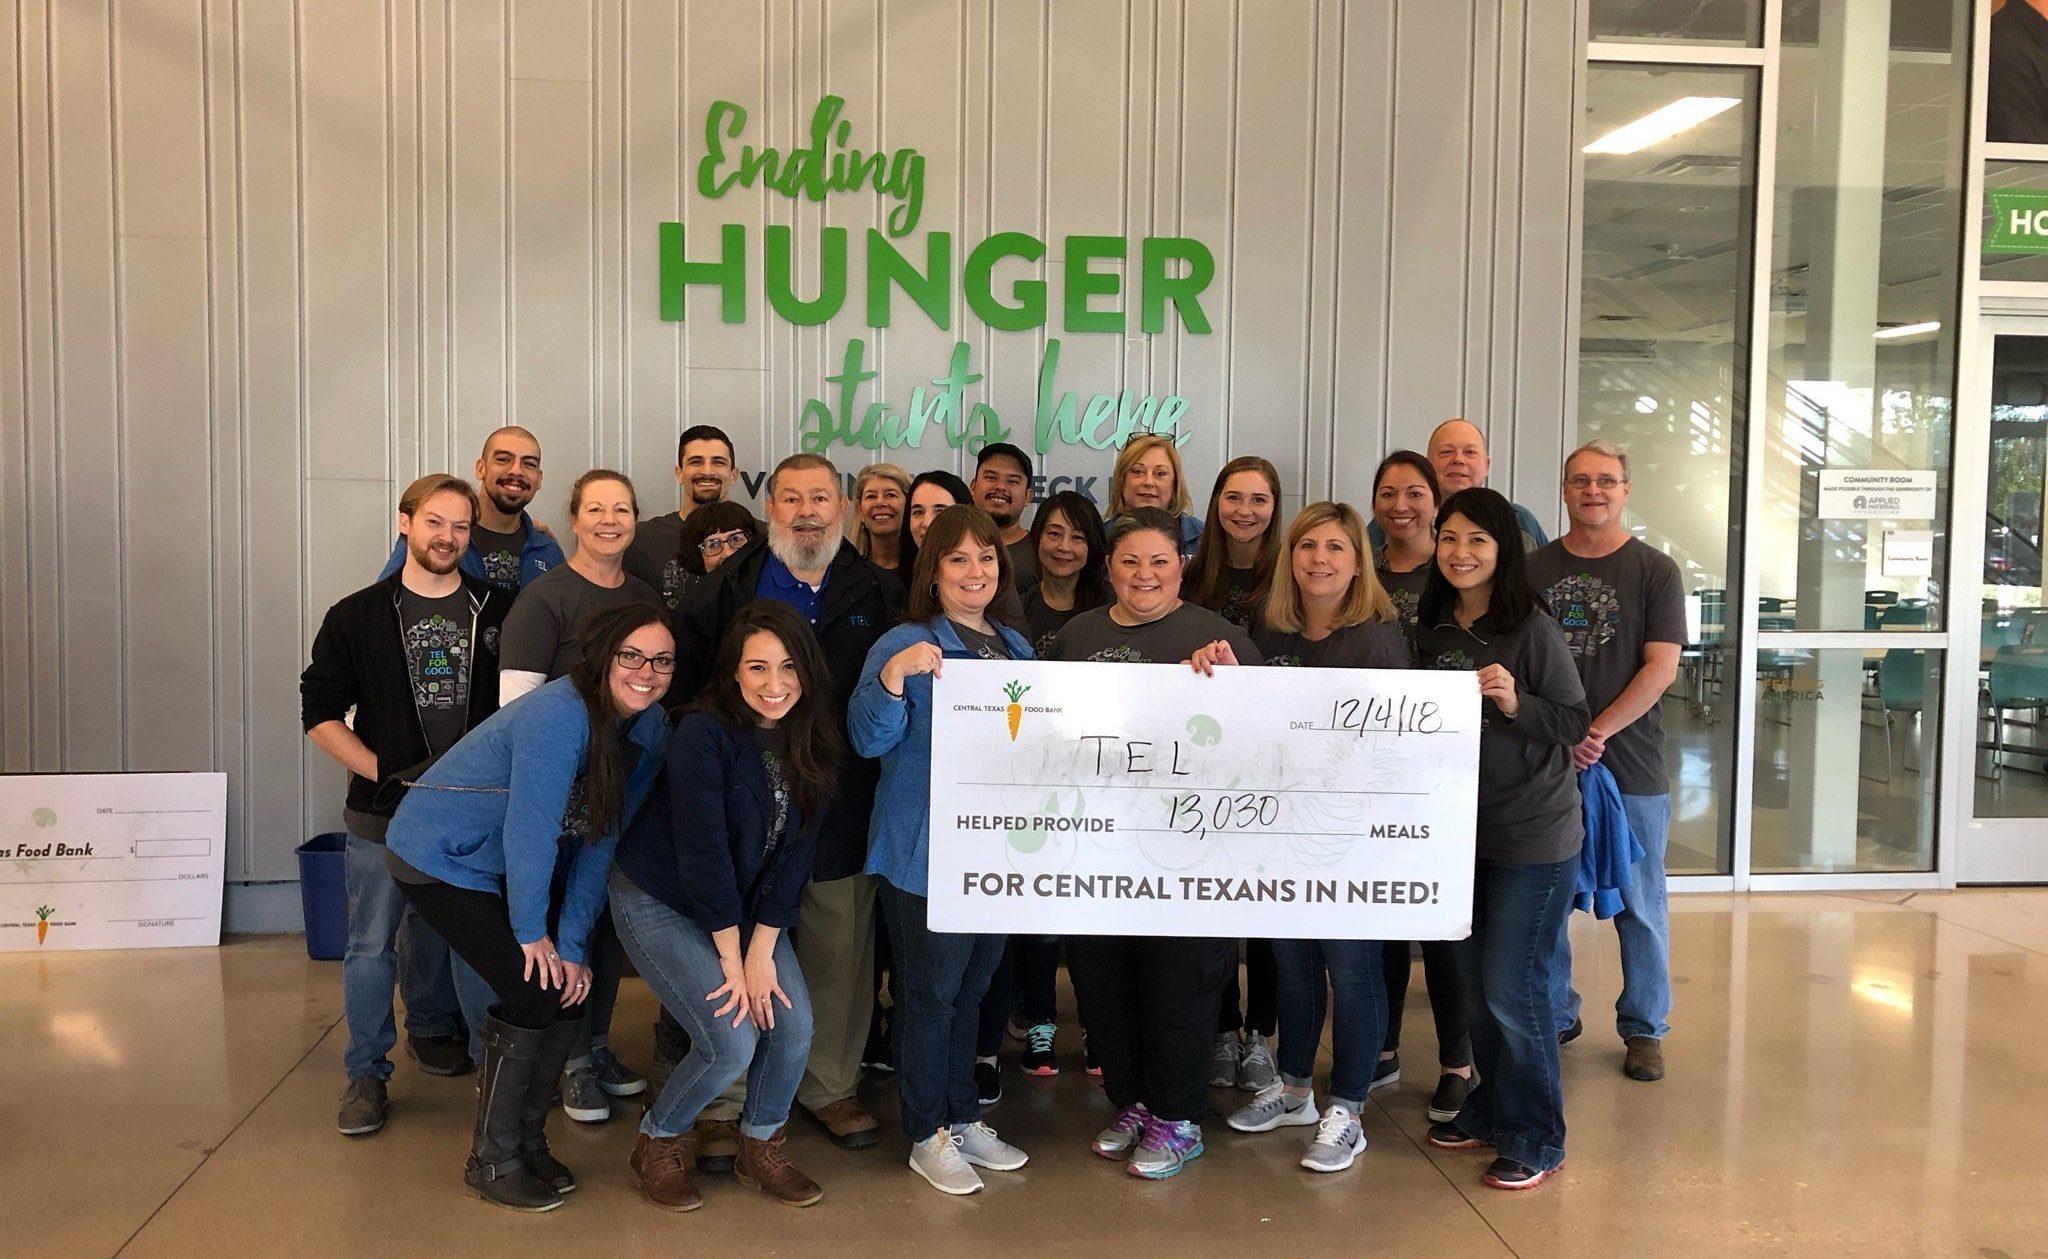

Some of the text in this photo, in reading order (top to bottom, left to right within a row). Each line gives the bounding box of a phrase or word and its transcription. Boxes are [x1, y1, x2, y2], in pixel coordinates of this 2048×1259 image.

[698, 95, 925, 238] Ending
[659, 221, 1215, 334] HUNGER
[800, 338, 1193, 455] starts here
[1843, 476, 1913, 484] COMMUNITY ROOM
[534, 559, 548, 572] TEL
[1563, 617, 1588, 626] GOOD
[430, 650, 447, 659] TEL
[429, 658, 448, 667] FOR
[425, 666, 453, 675] GOOD
[953, 704, 982, 712] CENTRAL
[1331, 694, 1443, 737] 12/4/18
[1290, 721, 1314, 731] DATE
[1081, 736, 1190, 776] TEL
[96, 807, 113, 815] DATE
[1169, 793, 1279, 840] 13,030
[956, 815, 1115, 833] HELPED PROVIDE
[1370, 824, 1430, 839] MEALS
[16, 843, 52, 857] Food
[56, 842, 94, 857] Bank
[963, 872, 1439, 904] FOR CENTRAL TEXANS IN NEED!
[138, 920, 175, 928] SIGNATURE
